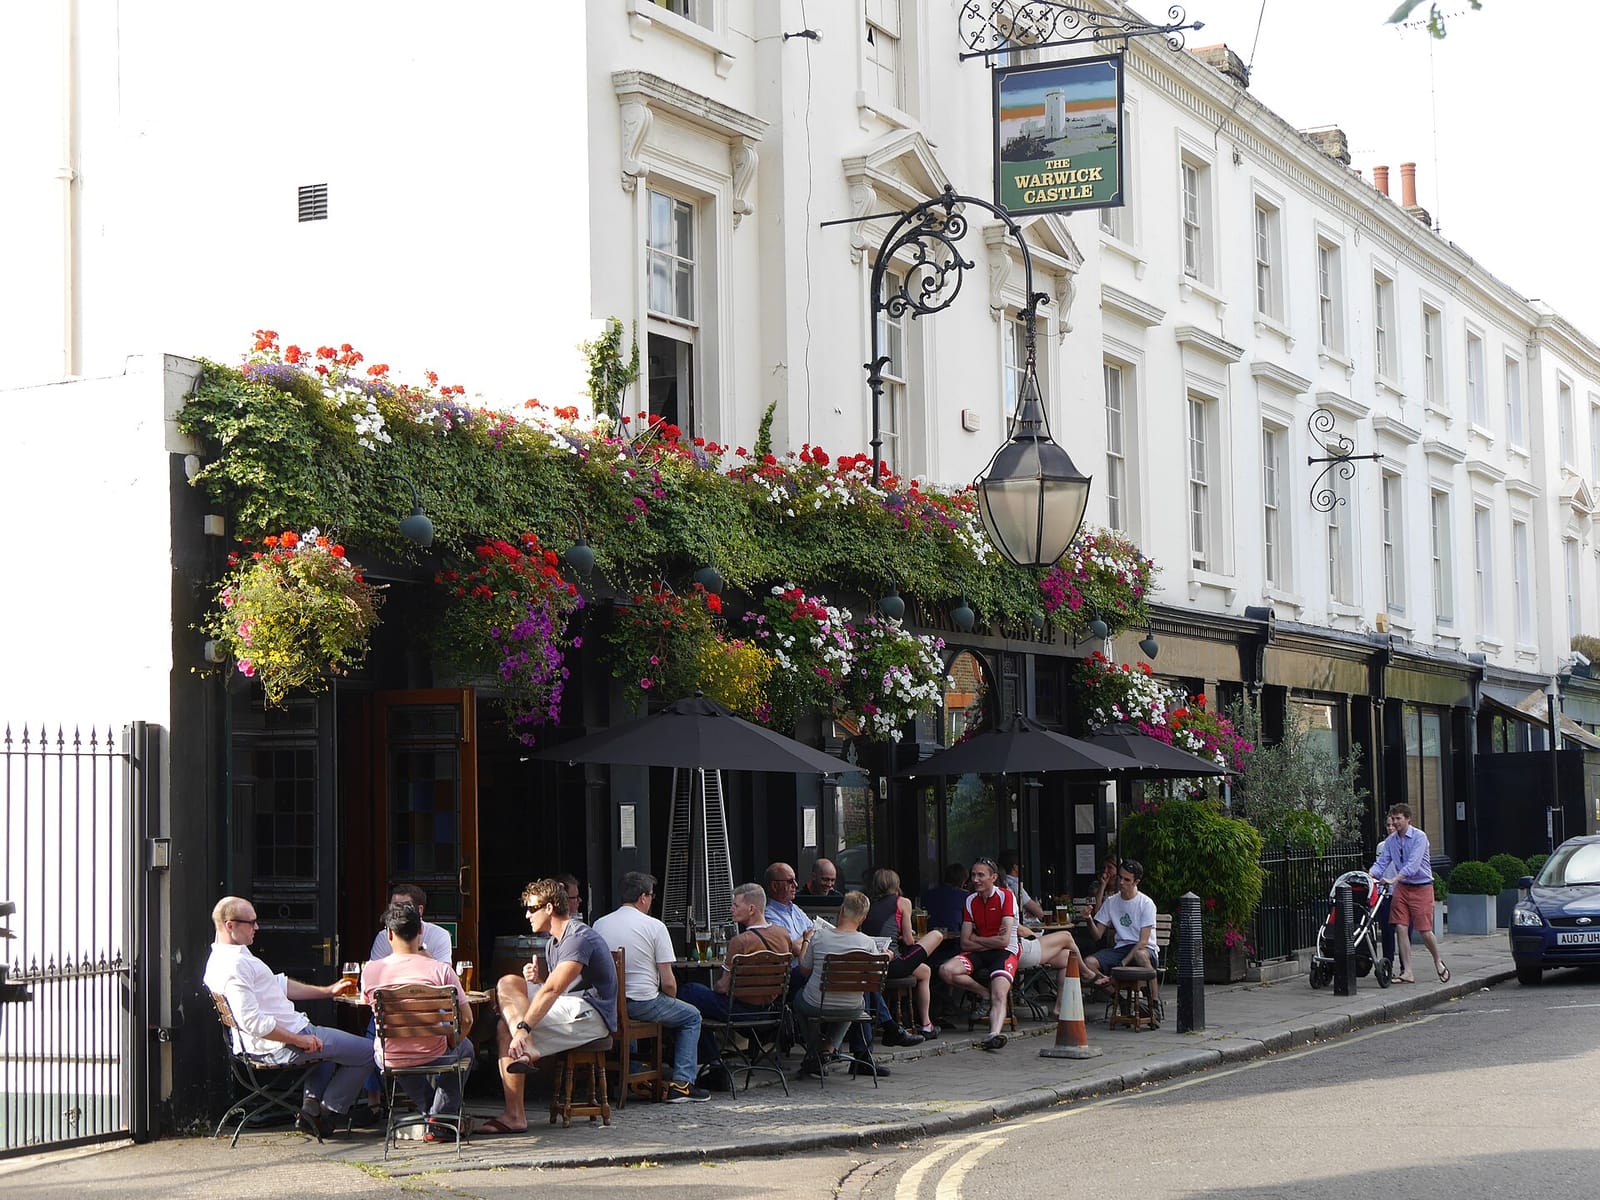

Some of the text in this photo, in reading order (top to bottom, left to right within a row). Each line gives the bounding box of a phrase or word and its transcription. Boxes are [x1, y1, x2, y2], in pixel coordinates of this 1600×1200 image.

[1045, 158, 1070, 170] THE
[1014, 167, 1103, 189] WARWICK
[1023, 184, 1093, 204] CASTLE
[1561, 934, 1585, 944] AU07
